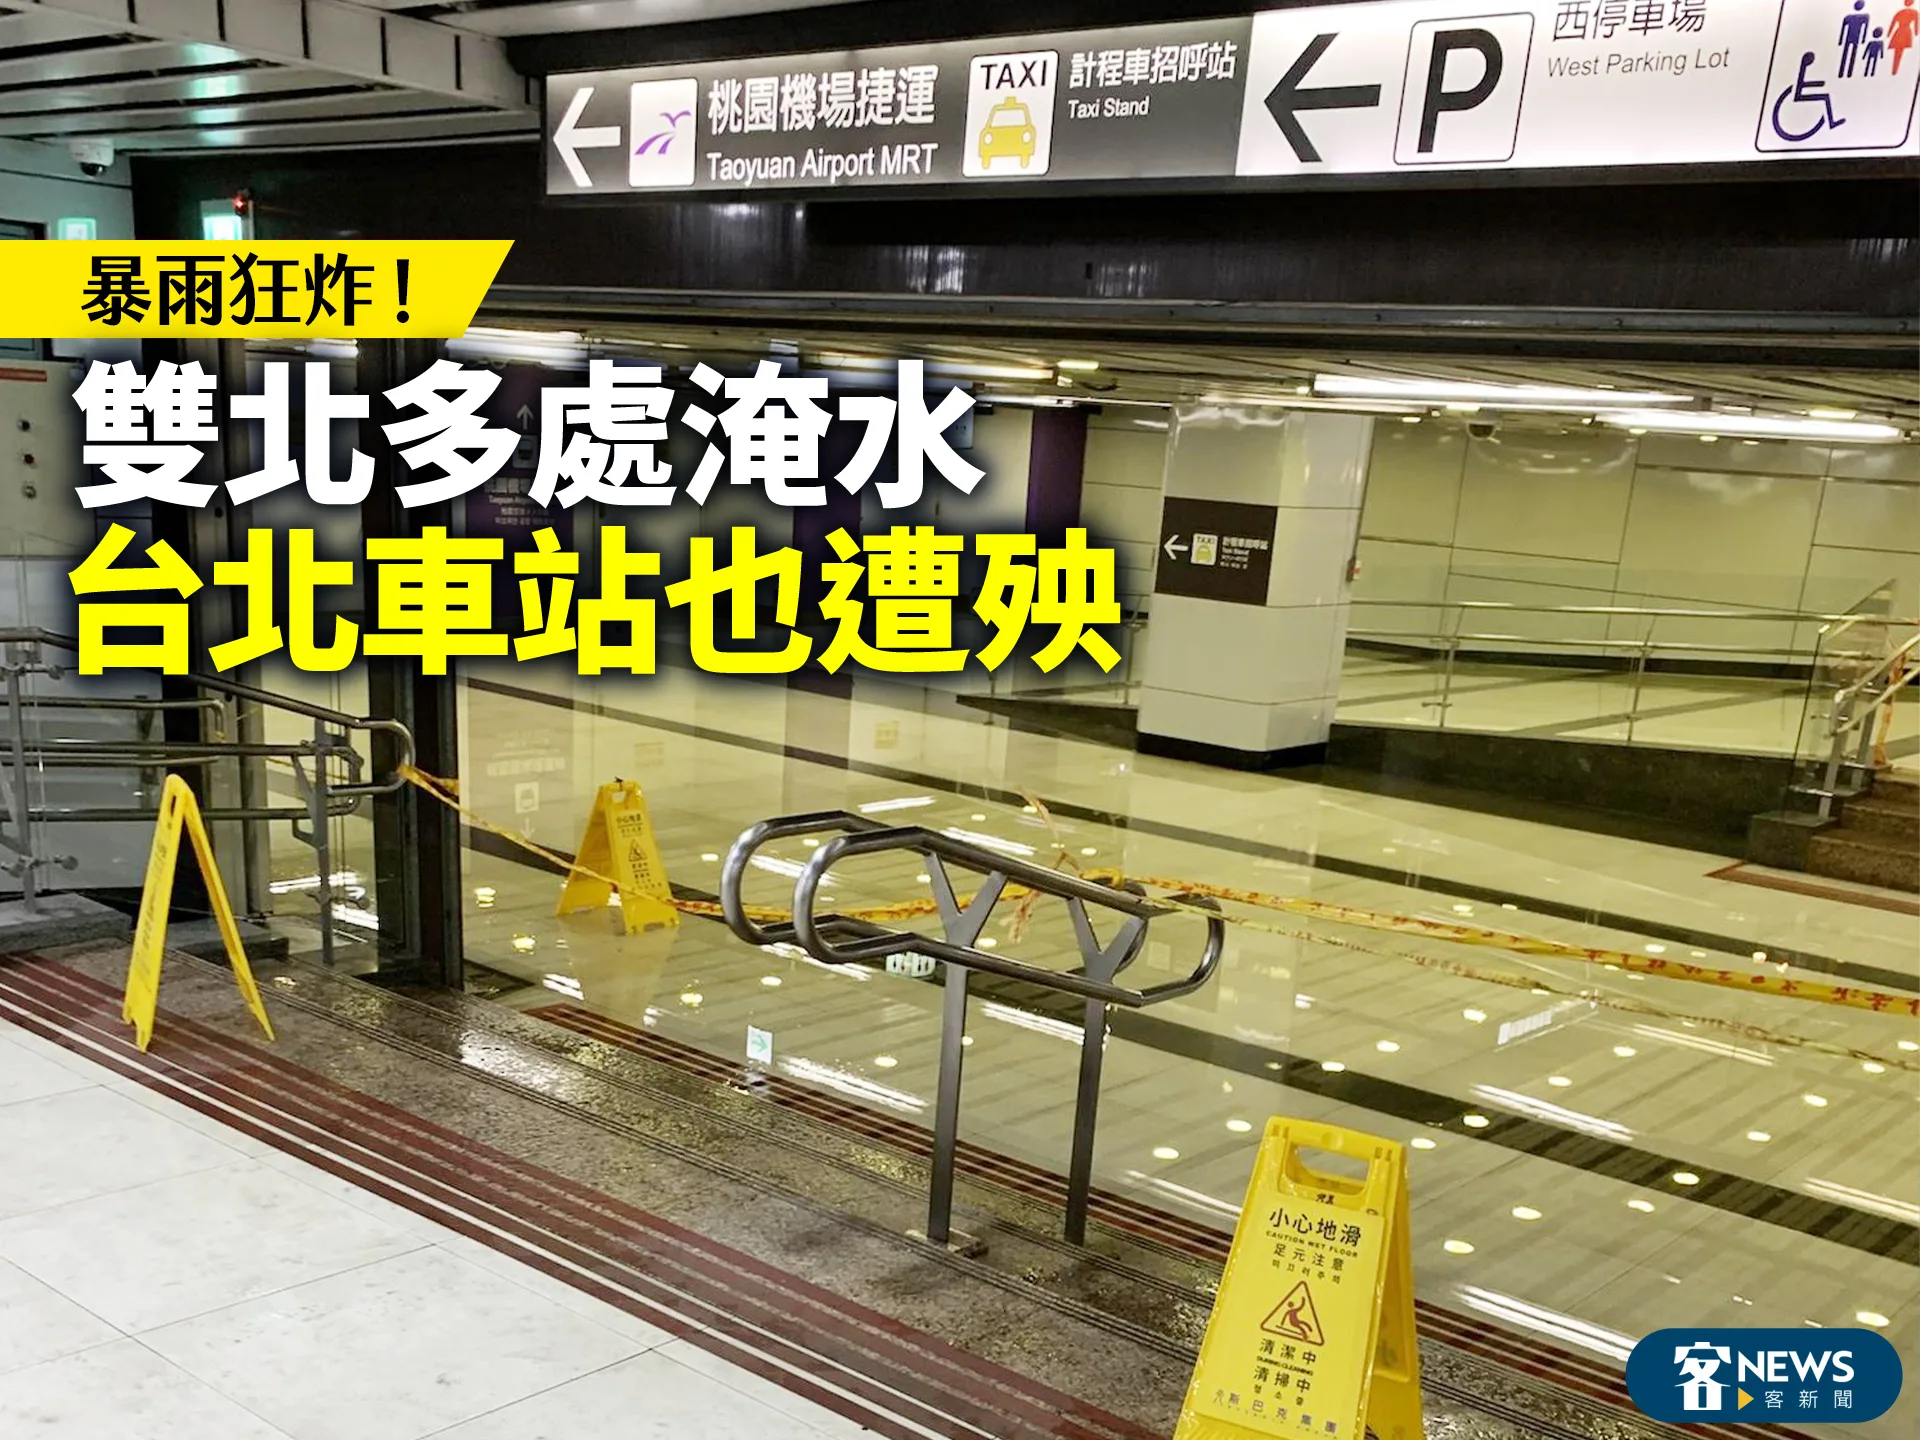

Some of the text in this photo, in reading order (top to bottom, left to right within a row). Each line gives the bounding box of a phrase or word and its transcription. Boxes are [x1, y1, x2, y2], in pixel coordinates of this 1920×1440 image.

[1552, 0, 1706, 42] 西停車場
[981, 59, 1048, 90] TAXI
[1069, 40, 1237, 89] 計程車招呼站
[1548, 48, 1729, 77] West Parking Lot
[708, 64, 939, 135] 桃園機場捷運
[1417, 28, 1503, 153] P
[1068, 96, 1150, 119] Taxi Stand
[706, 143, 939, 187] Taoyuan Airport MRT
[1269, 1207, 1361, 1247] 小心地滑
[1266, 1230, 1358, 1258] CAUTION WET FLOOR
[1273, 1242, 1344, 1271] 足元注意
[1259, 1338, 1317, 1365] 清潔中
[1253, 1365, 1311, 1393] 清掃中
